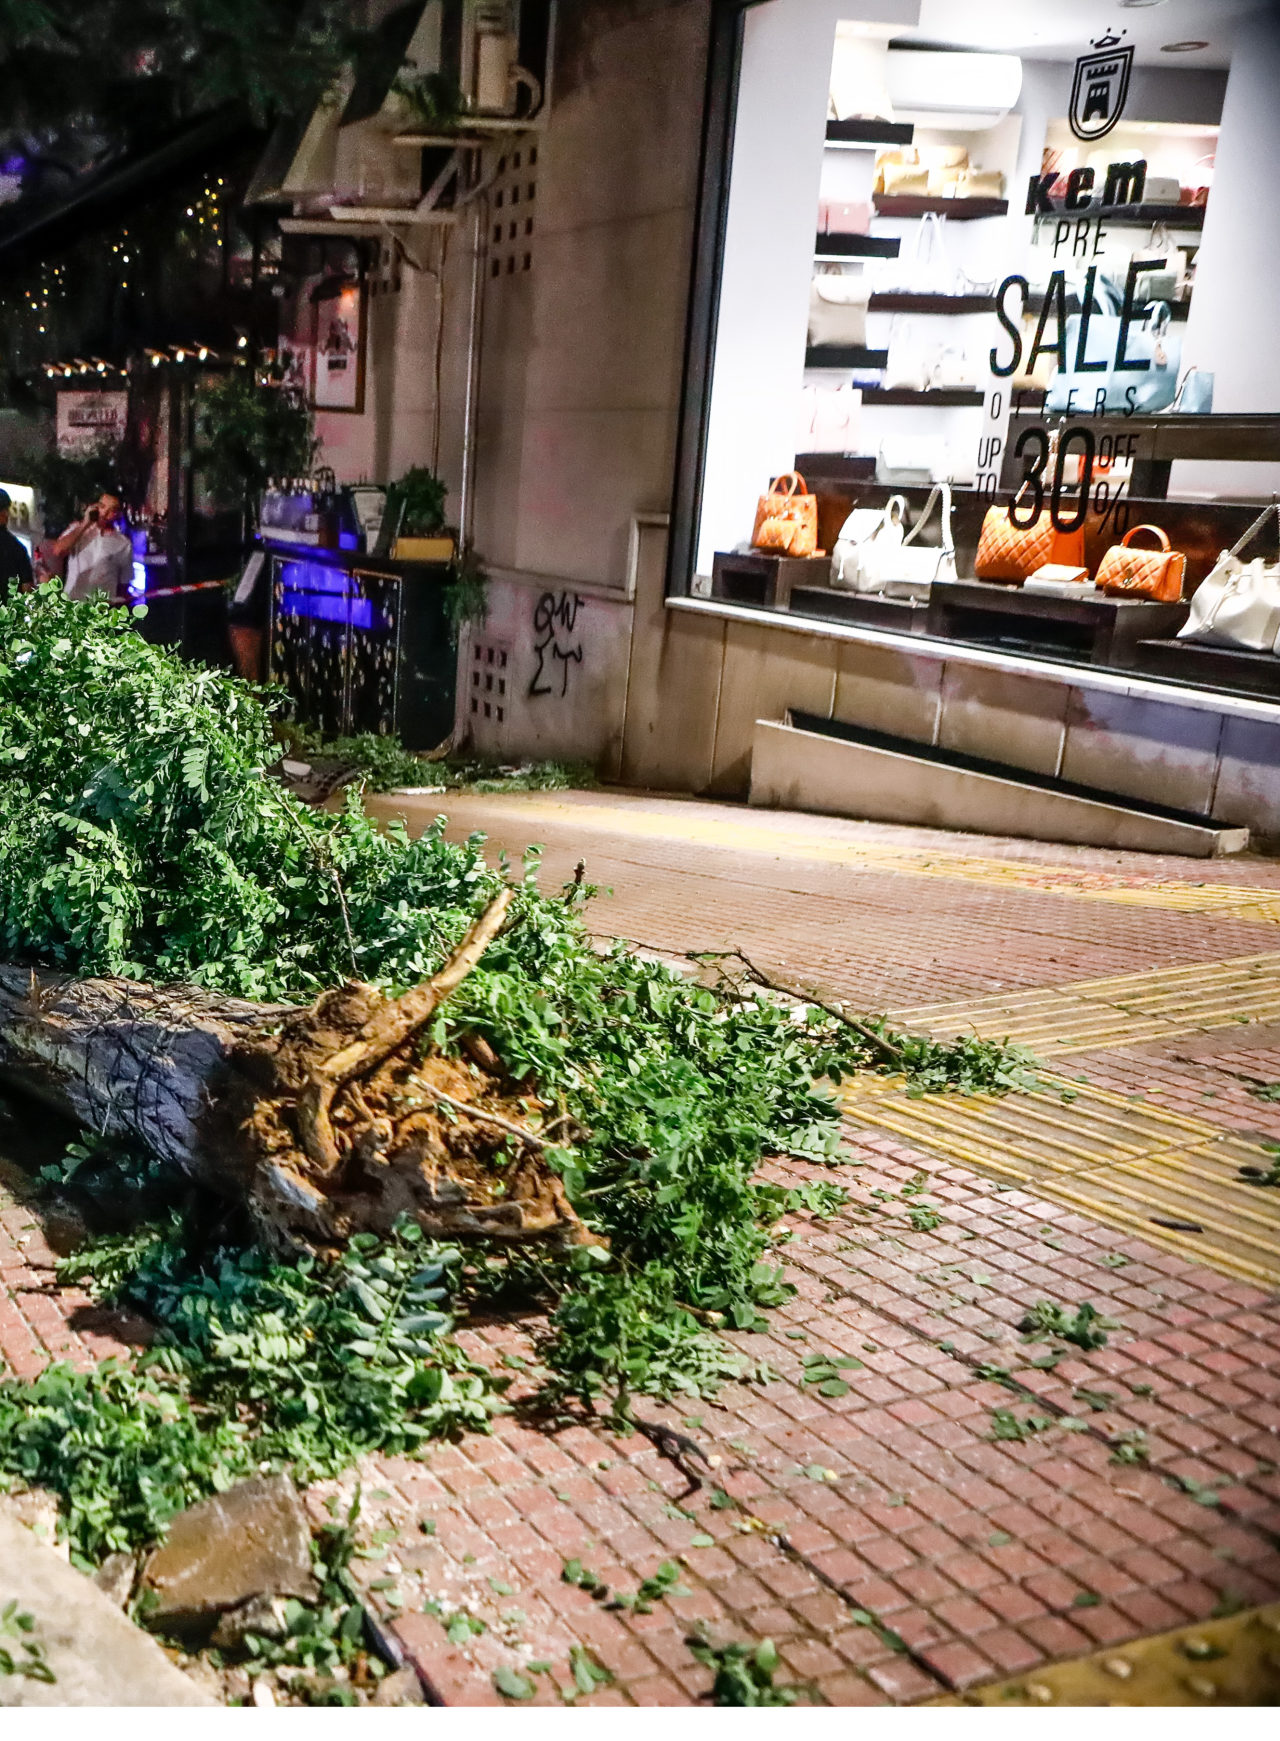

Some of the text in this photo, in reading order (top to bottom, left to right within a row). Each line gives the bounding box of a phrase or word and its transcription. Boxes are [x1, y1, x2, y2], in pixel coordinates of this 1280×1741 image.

[1025, 159, 1148, 215] kem
[1053, 214, 1111, 258] PRE
[989, 258, 1168, 377] SALE
[990, 386, 1137, 420] OFFERS
[977, 437, 1002, 469] UP
[1098, 434, 1140, 469] OFF
[975, 473, 998, 503] TO
[1008, 427, 1095, 534] 30
[1092, 481, 1130, 536] %
